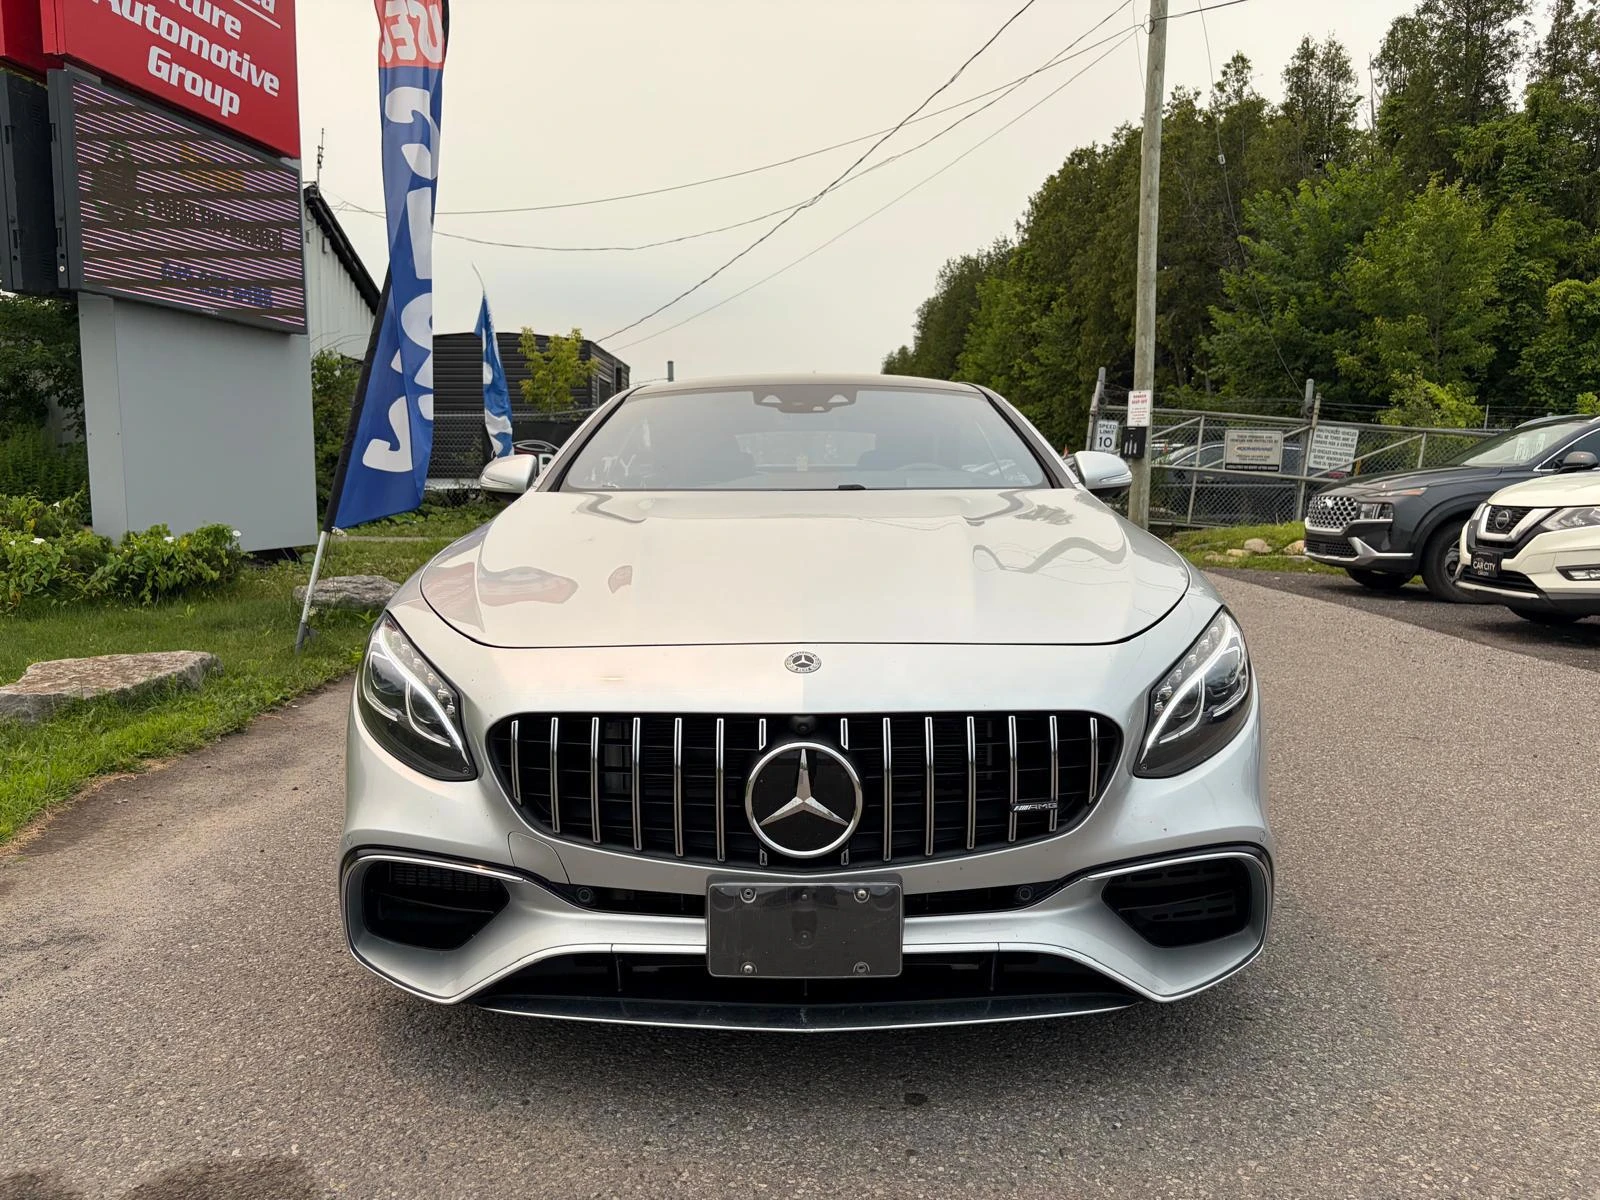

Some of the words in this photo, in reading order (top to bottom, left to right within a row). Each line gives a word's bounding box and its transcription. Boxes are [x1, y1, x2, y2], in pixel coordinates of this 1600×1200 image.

[169, 0, 242, 40] ture
[148, 45, 240, 118] Group
[1099, 436, 1113, 448] 10
[1473, 561, 1483, 569] CAR
[1484, 563, 1496, 571] CITY
[1030, 802, 1058, 810] AMG
